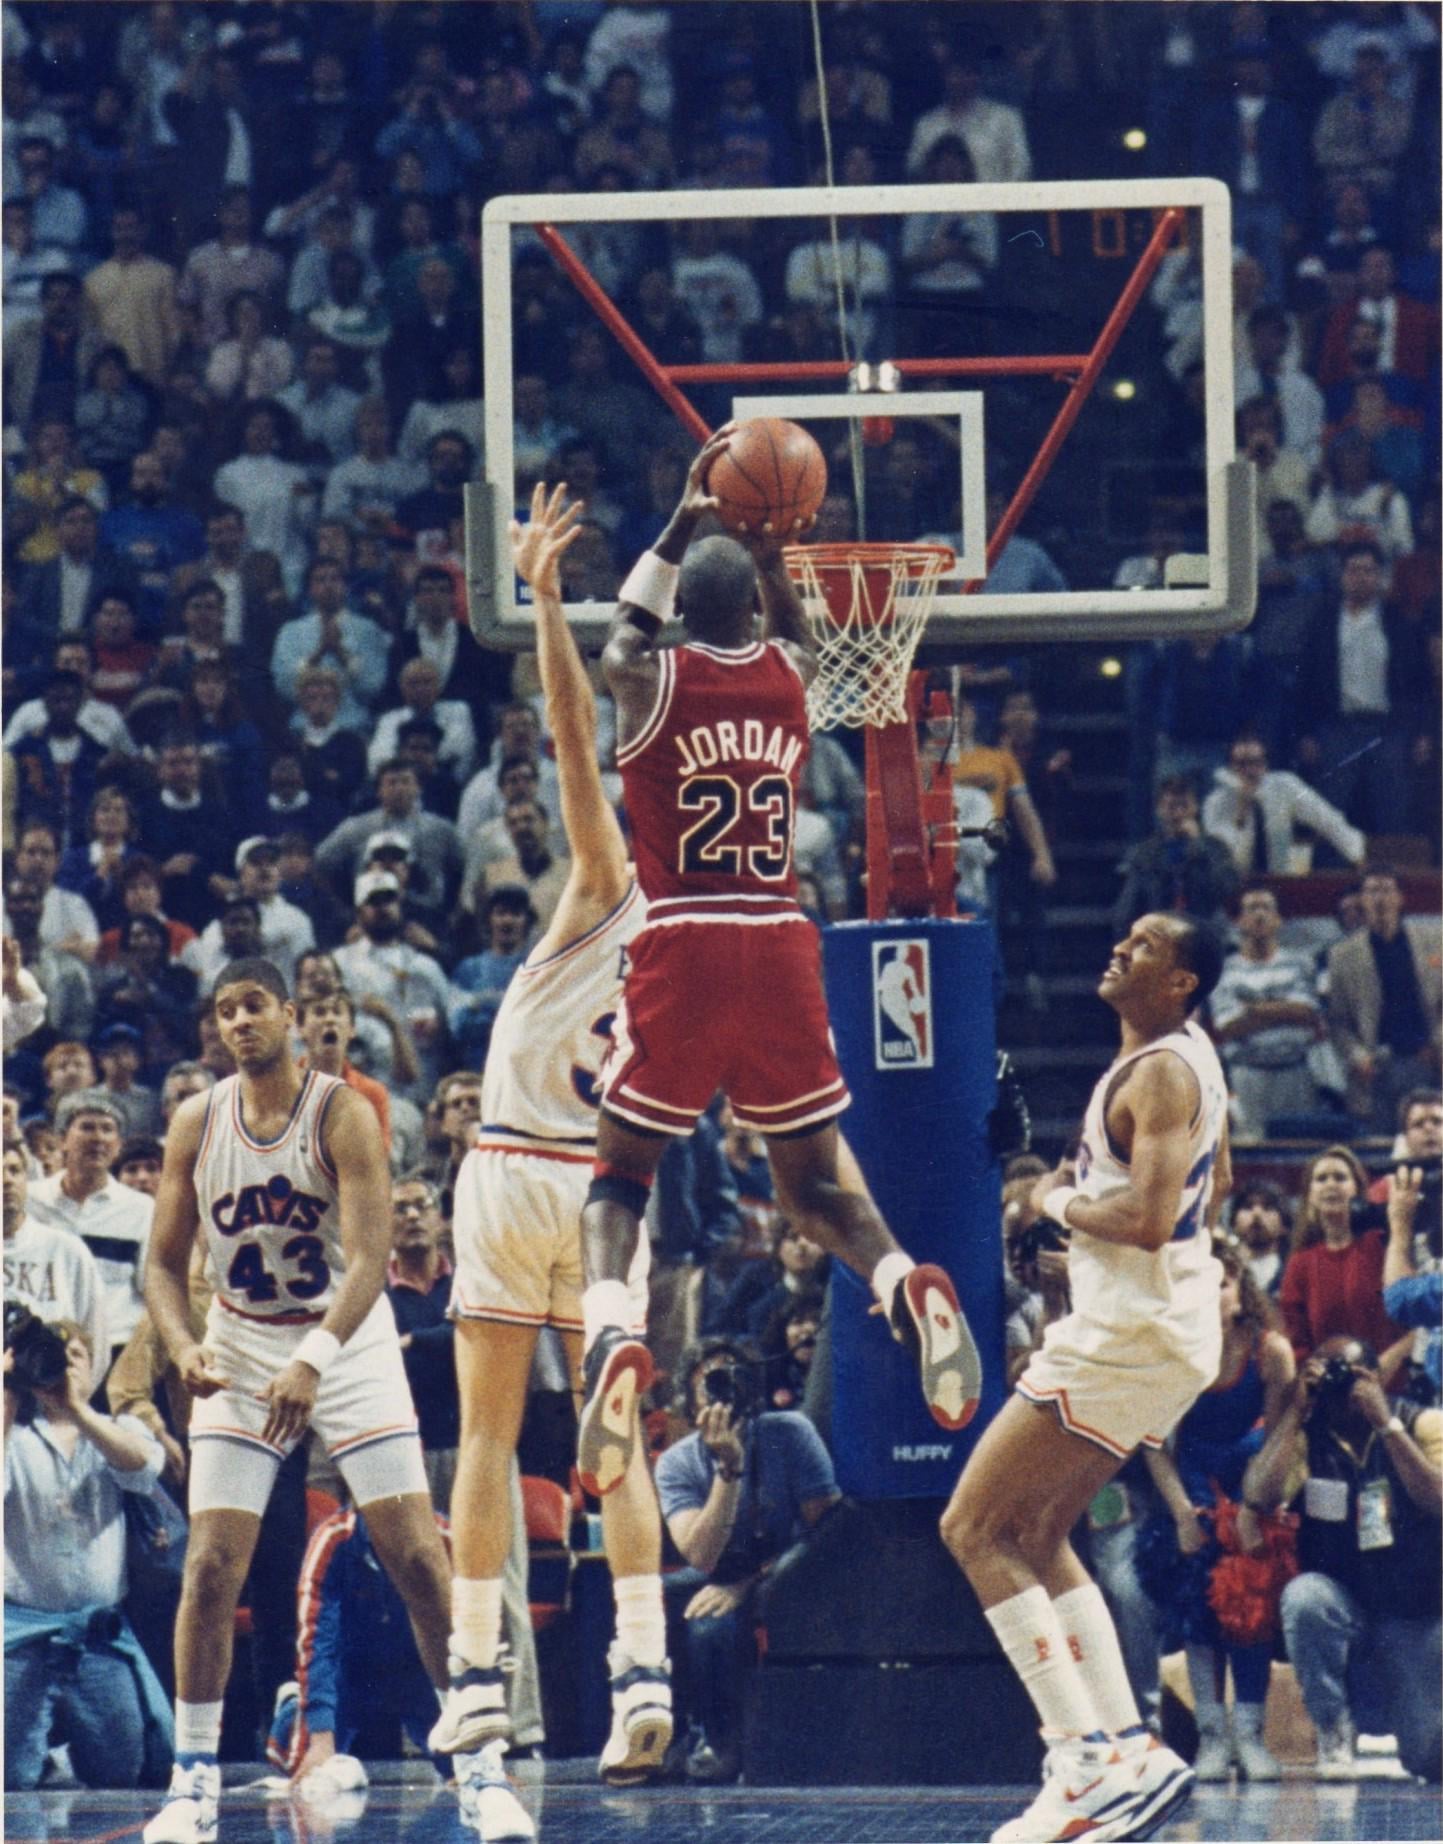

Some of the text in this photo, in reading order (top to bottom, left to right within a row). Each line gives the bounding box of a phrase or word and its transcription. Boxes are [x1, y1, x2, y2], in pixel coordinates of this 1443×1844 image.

[674, 720, 802, 776] JORDAN
[678, 774, 793, 882] 23
[212, 1174, 330, 1237] CAVS
[228, 1235, 331, 1302] 43
[893, 1444, 953, 1461] HUFFY
